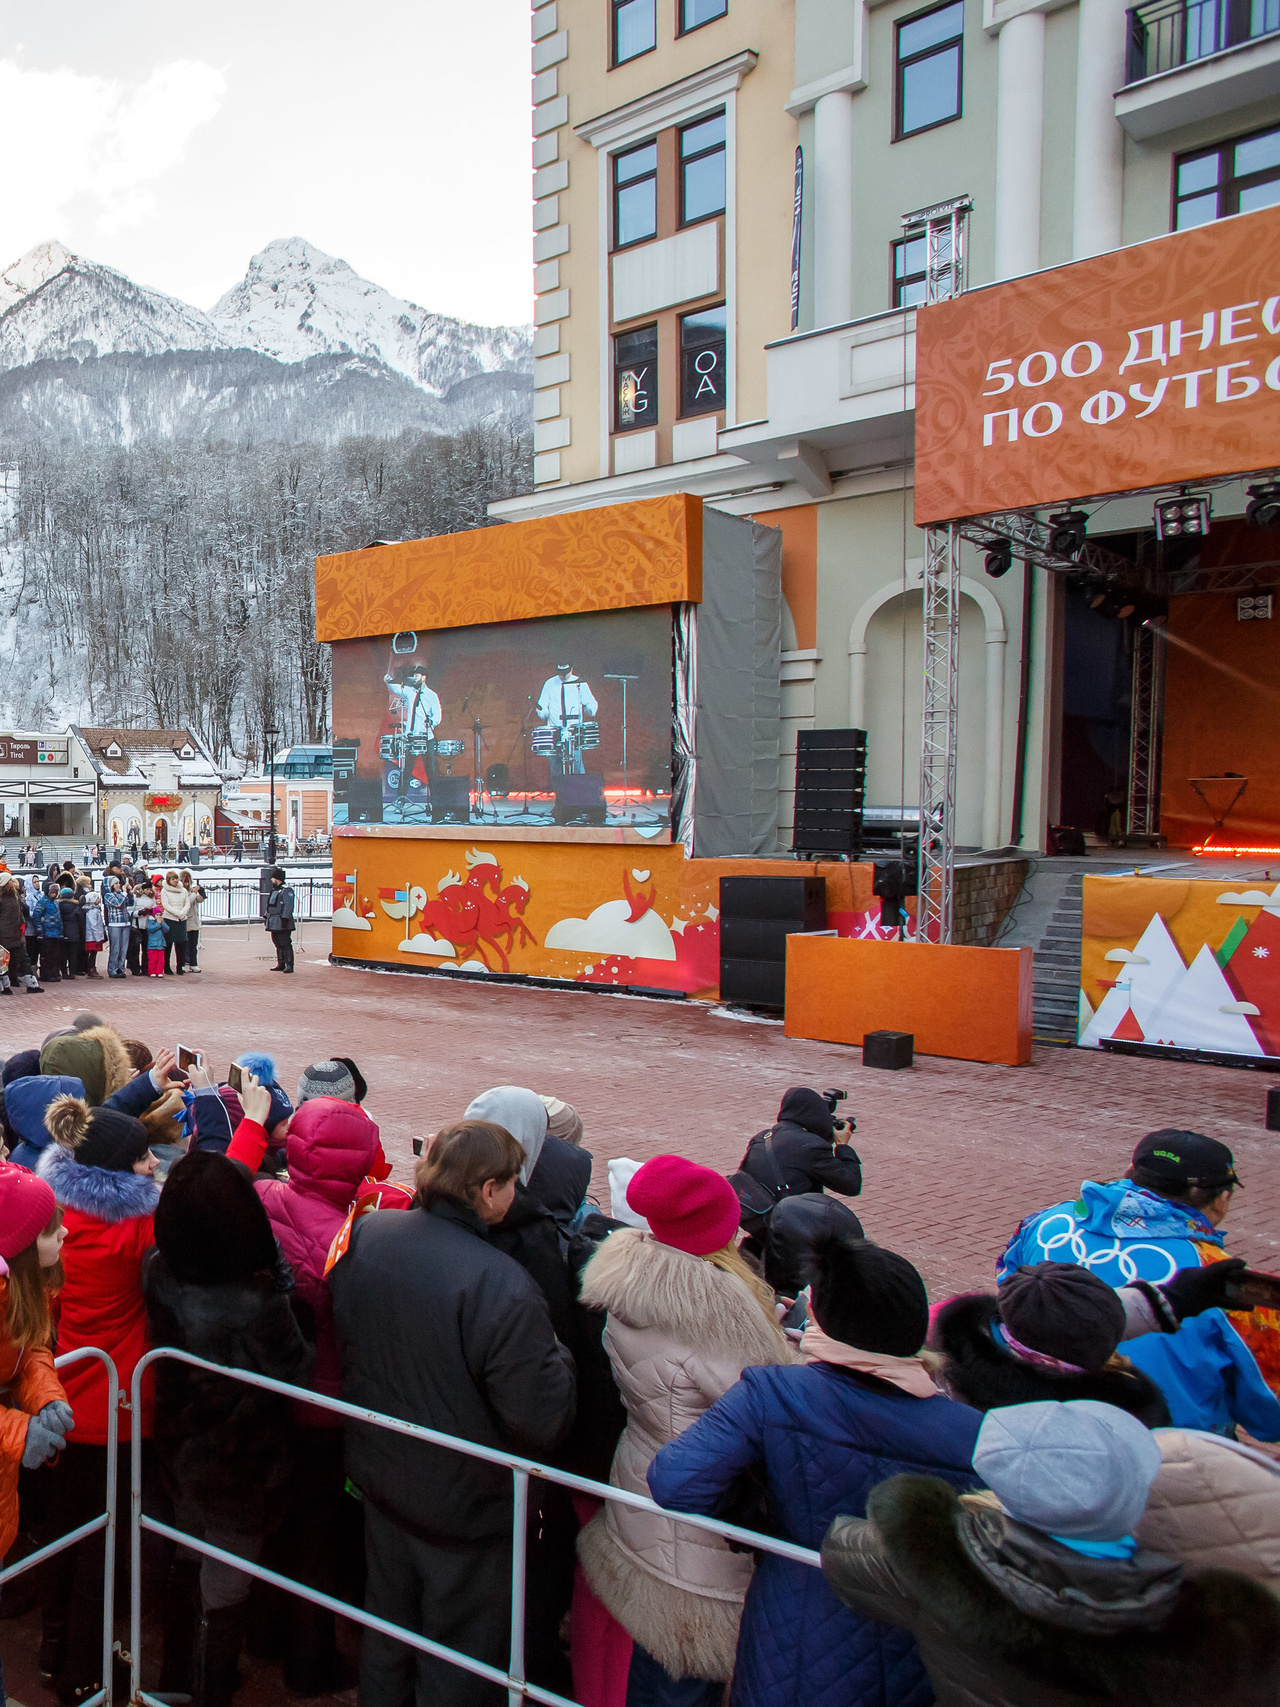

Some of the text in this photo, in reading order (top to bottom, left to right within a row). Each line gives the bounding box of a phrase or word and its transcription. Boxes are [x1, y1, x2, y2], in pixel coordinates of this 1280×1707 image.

[982, 341, 1104, 397] 500
[622, 374, 632, 416] МАССАЖ
[982, 401, 1064, 447] ПО
[10, 742, 31, 750] Тироль
[10, 751, 24, 759] Tirol
